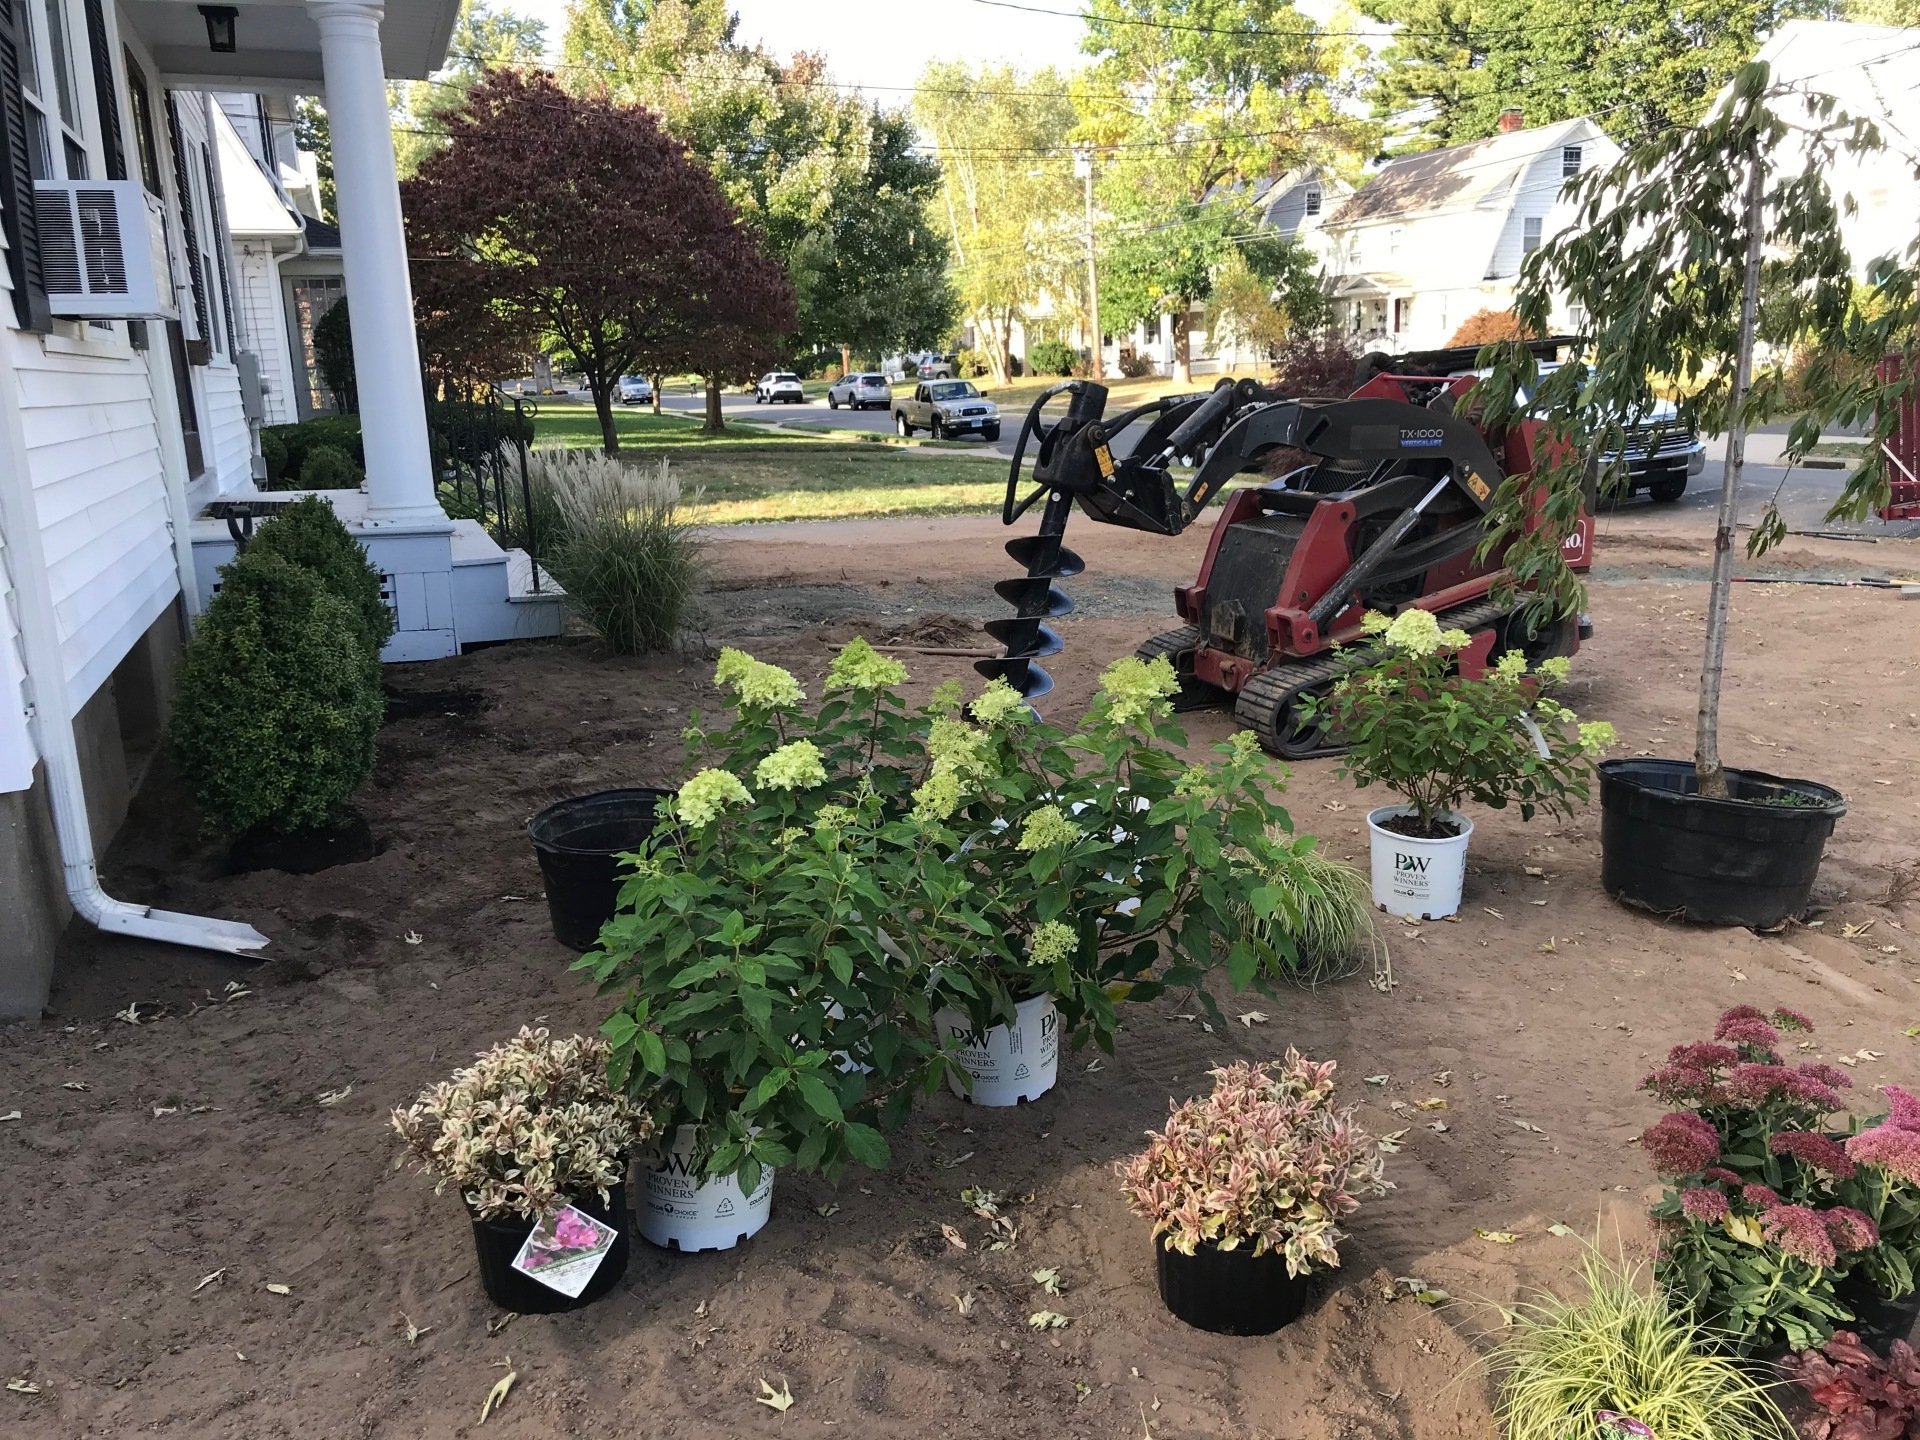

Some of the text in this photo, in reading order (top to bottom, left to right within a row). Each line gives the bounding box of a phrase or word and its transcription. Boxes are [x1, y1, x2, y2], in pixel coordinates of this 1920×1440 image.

[1394, 852, 1432, 873] PW
[1393, 876, 1429, 887] WINNERS
[1396, 870, 1427, 881] PROVEN
[955, 1048, 991, 1059] PROVEN
[648, 1172, 690, 1189] PROVEN
[645, 1180, 694, 1199] WINNERS
